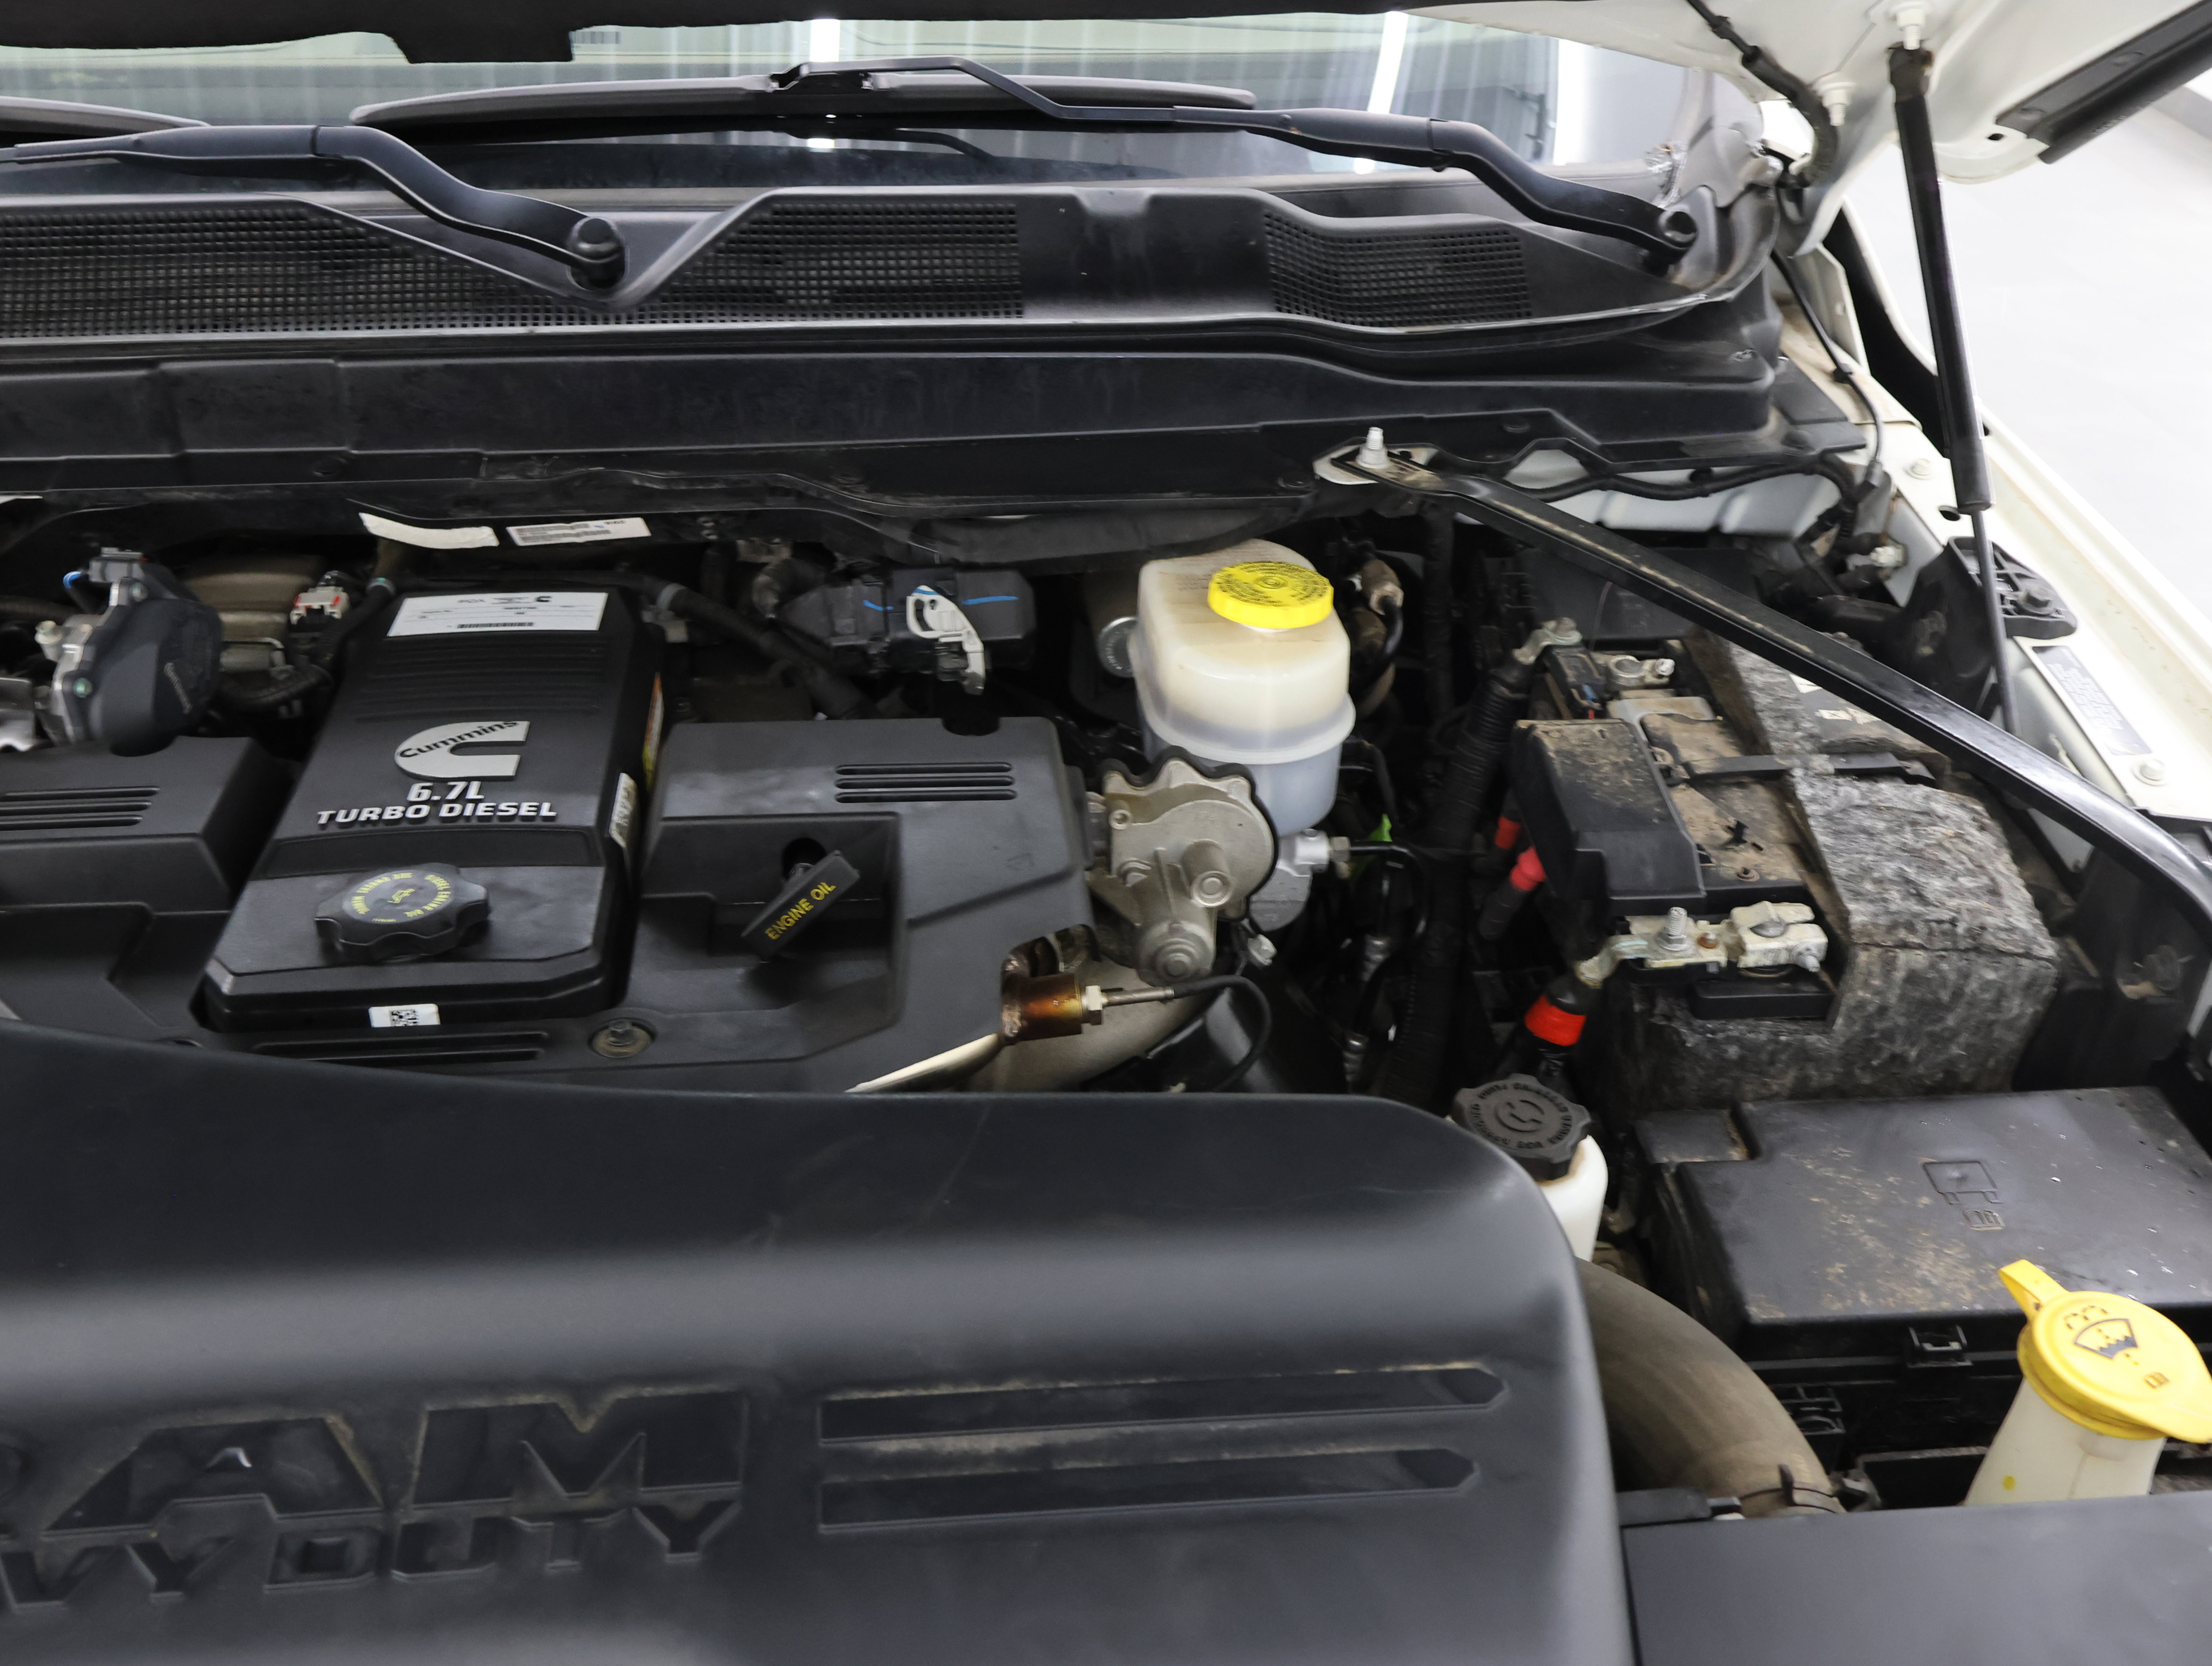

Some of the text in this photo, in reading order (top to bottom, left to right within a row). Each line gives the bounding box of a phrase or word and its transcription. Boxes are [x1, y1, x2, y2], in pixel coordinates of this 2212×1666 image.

[399, 720, 519, 758] Cummins
[317, 802, 557, 824] TURBO DIESEL
[407, 781, 484, 801] 6.7L
[765, 882, 836, 939] ENGINE OIL
[0, 1388, 749, 1538] AM
[263, 1501, 743, 1595] DUTY
